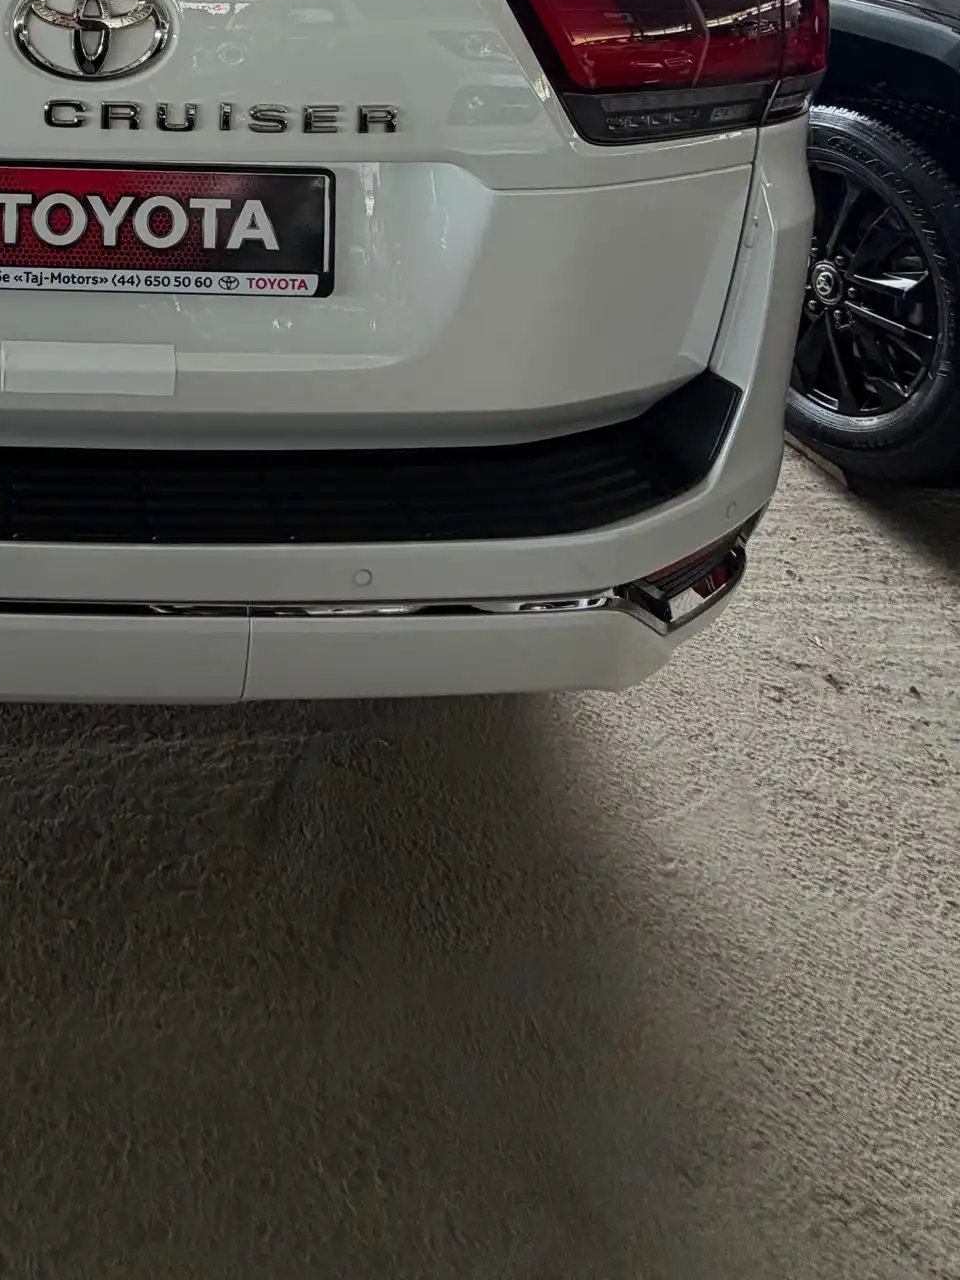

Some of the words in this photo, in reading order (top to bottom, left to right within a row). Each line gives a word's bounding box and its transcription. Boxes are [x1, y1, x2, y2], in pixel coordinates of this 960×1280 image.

[43, 99, 397, 134] CRUISER
[14, 271, 109, 287] «Taj-Motors»
[111, 274, 141, 288] (44)
[144, 275, 171, 288] 650
[173, 276, 191, 289] 50
[194, 276, 213, 289] 60
[246, 277, 309, 291] TOYOTA
